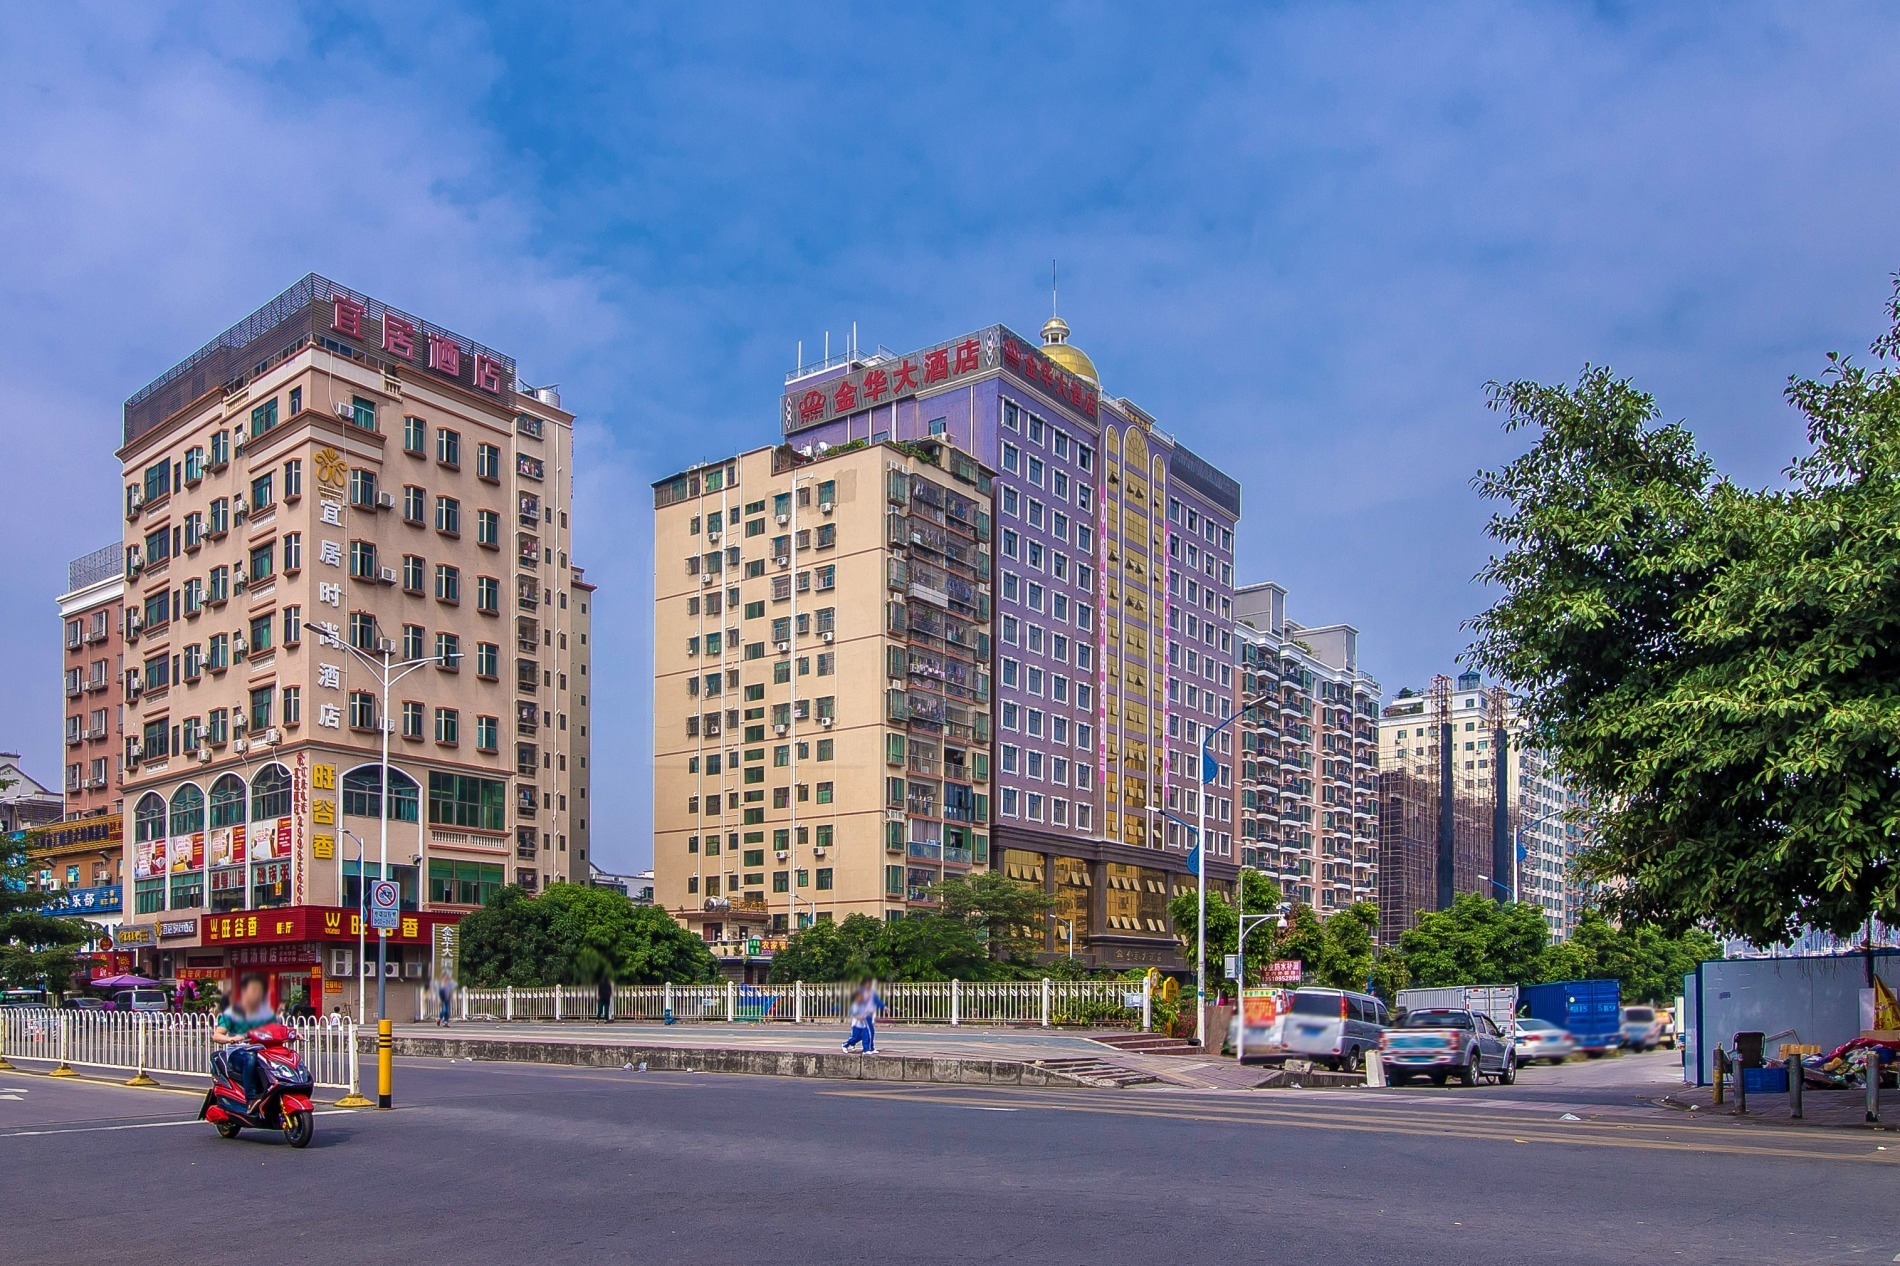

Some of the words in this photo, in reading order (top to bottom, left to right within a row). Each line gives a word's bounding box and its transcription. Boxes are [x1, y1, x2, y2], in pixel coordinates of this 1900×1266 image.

[330, 292, 501, 395] 宜居酒店
[833, 338, 980, 413] 金华大酒店
[1024, 352, 1096, 418] 金华大酒店
[318, 500, 342, 729] 宜居时尚酒店
[313, 763, 335, 860] 旺谷香
[221, 916, 257, 939] 旺谷香
